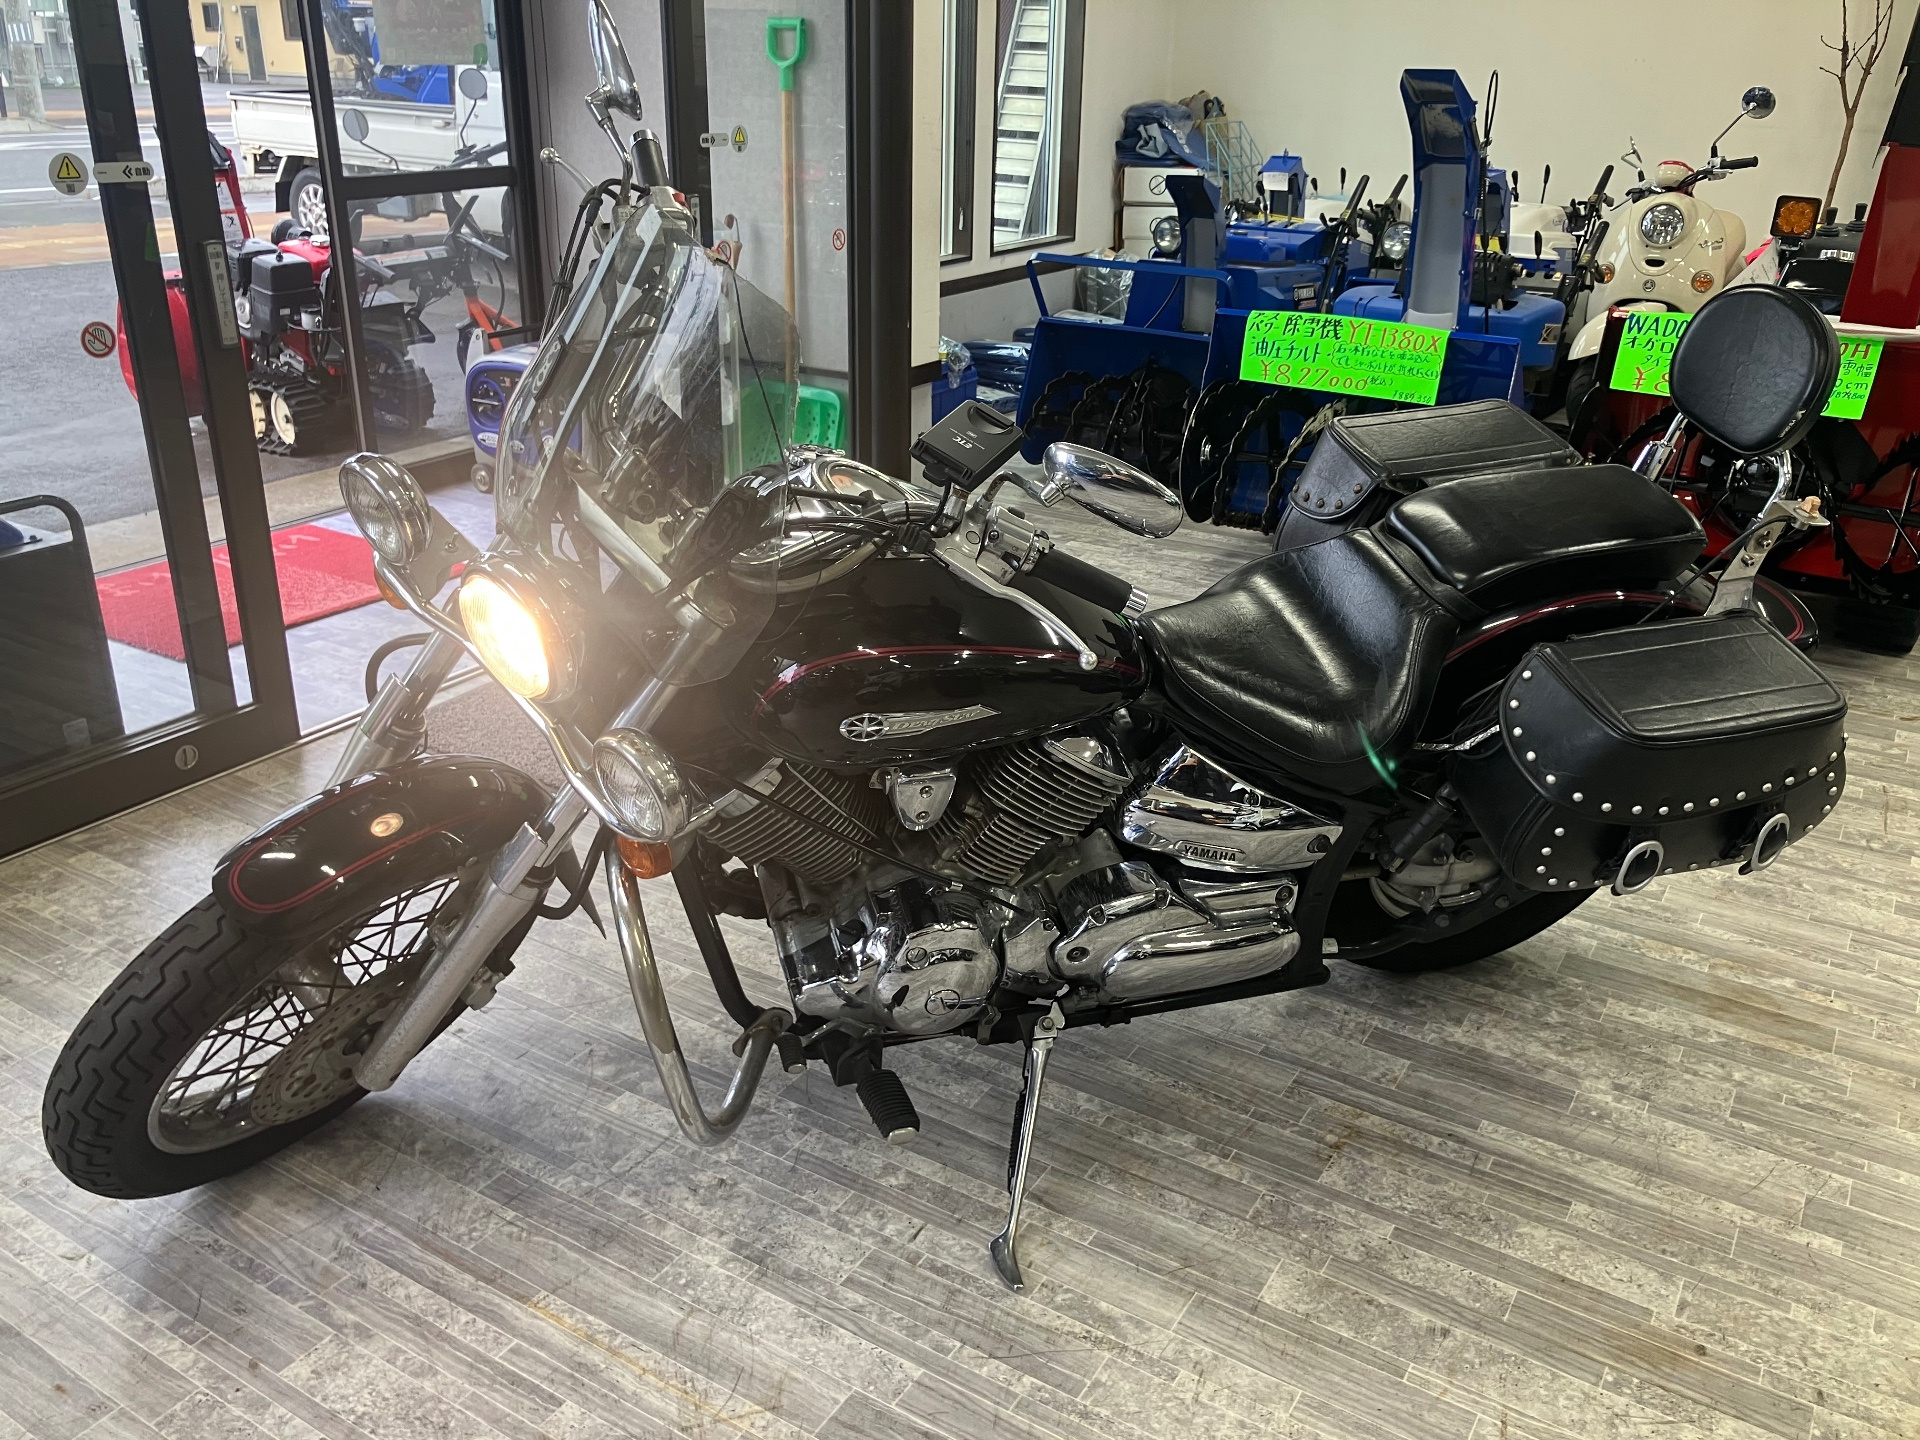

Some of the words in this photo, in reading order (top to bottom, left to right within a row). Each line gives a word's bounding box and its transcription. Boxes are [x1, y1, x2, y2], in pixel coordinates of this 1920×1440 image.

[1283, 314, 1344, 341] 除雪機
[952, 435, 973, 450] ETC
[1184, 844, 1237, 862] YAMAHA
